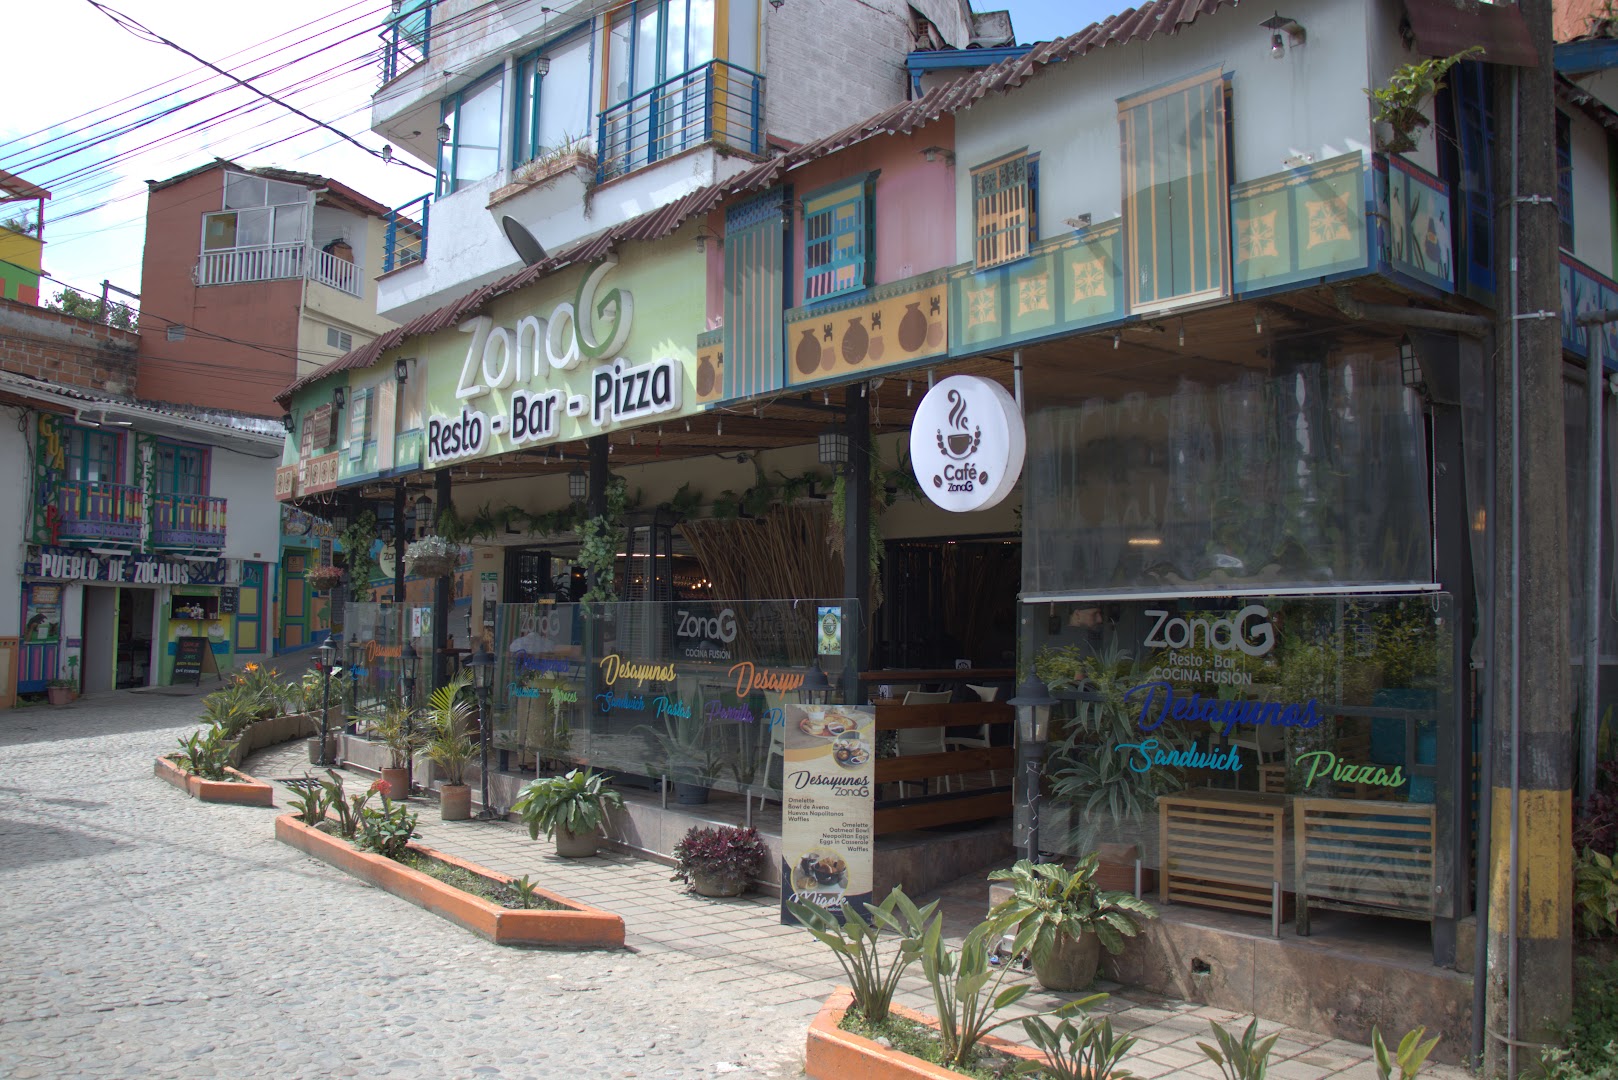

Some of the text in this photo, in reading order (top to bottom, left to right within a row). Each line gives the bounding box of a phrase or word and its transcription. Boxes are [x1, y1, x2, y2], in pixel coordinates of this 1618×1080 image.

[456, 253, 633, 399] ZonaG
[428, 410, 482, 458] Resto
[511, 391, 557, 439] Bar
[594, 364, 671, 421] Pizza
[944, 462, 977, 481] Café
[948, 481, 974, 492] ZonaG
[141, 446, 158, 554] WELCOME
[40, 554, 189, 585] PUEBLO DE ZÓCALOS
[677, 608, 737, 643] ZonaG
[1143, 604, 1275, 656] ZonaG
[685, 647, 708, 658] COCINA
[1169, 651, 1203, 667] Resto
[1214, 655, 1236, 668] Bar
[600, 654, 676, 688] Desayunos
[1153, 667, 1252, 686] COCINA FUSIÓN
[595, 691, 692, 719] Sandwich Pastas
[1124, 681, 1325, 736] Desayunos
[1115, 739, 1406, 789] Sandwich Pizzas
[788, 770, 870, 790] Desayunos
[834, 786, 870, 798] ZonaG
